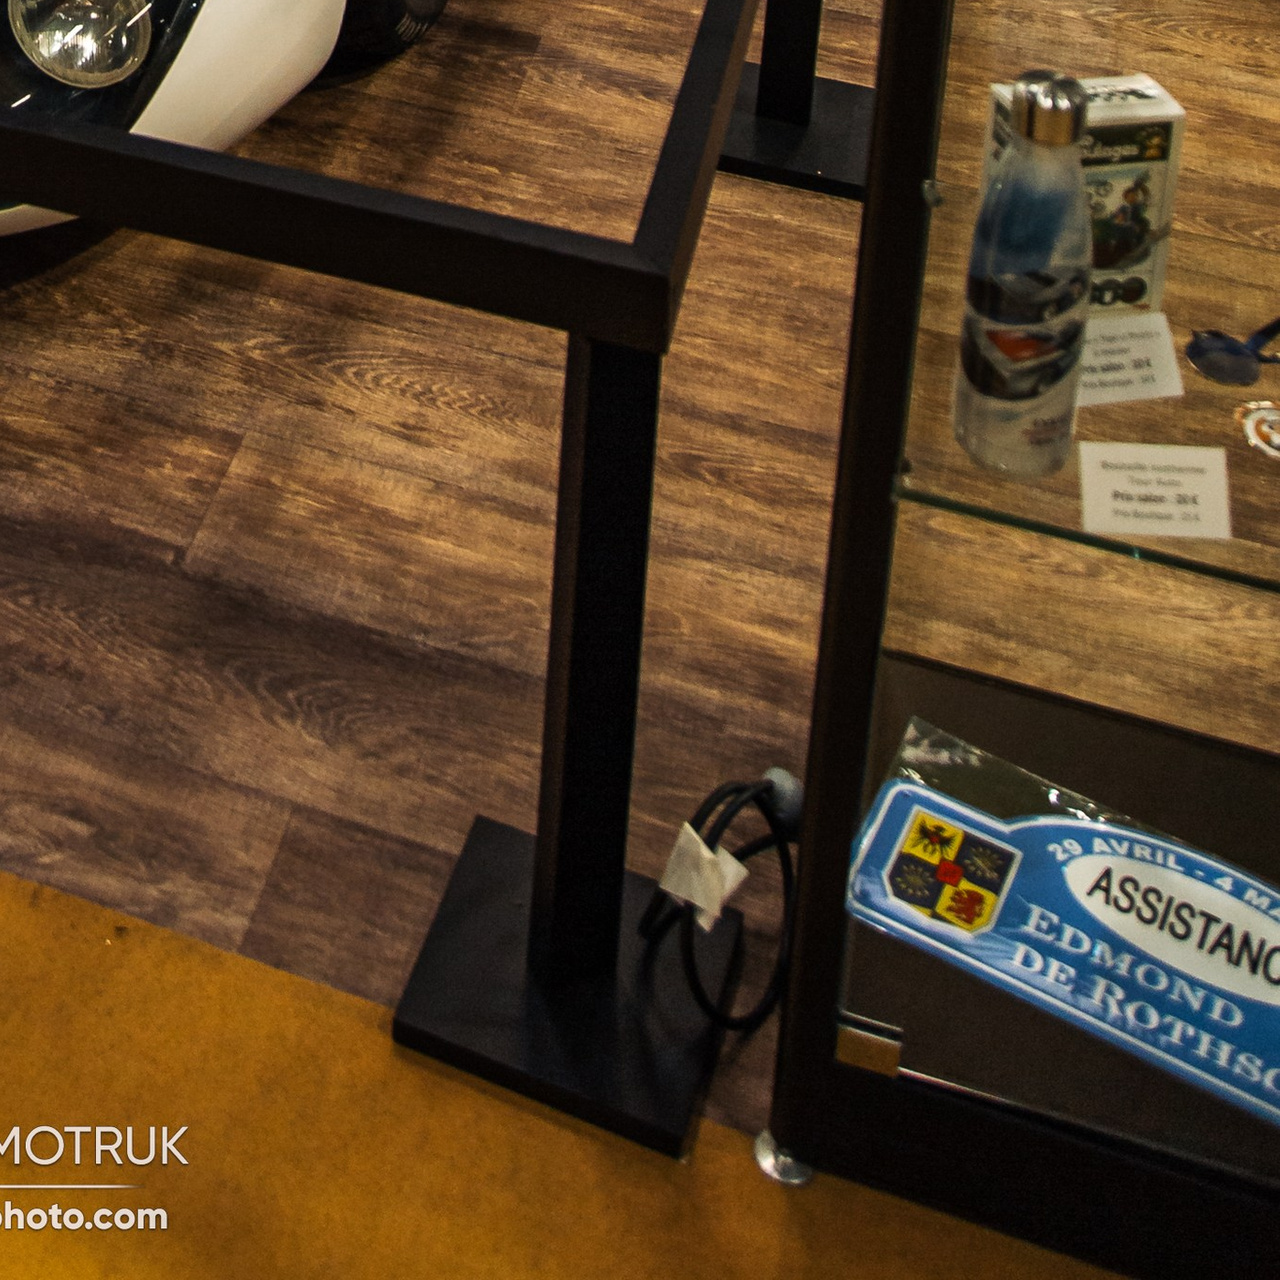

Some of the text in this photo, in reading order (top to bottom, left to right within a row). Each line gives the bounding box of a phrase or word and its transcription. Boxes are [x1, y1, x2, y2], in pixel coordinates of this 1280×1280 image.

[1047, 838, 1083, 861] 29
[1092, 837, 1185, 871] AVRIL
[1214, 876, 1234, 891] 4
[1009, 942, 1077, 992] DE
[1024, 903, 1244, 1028] EDMOND
